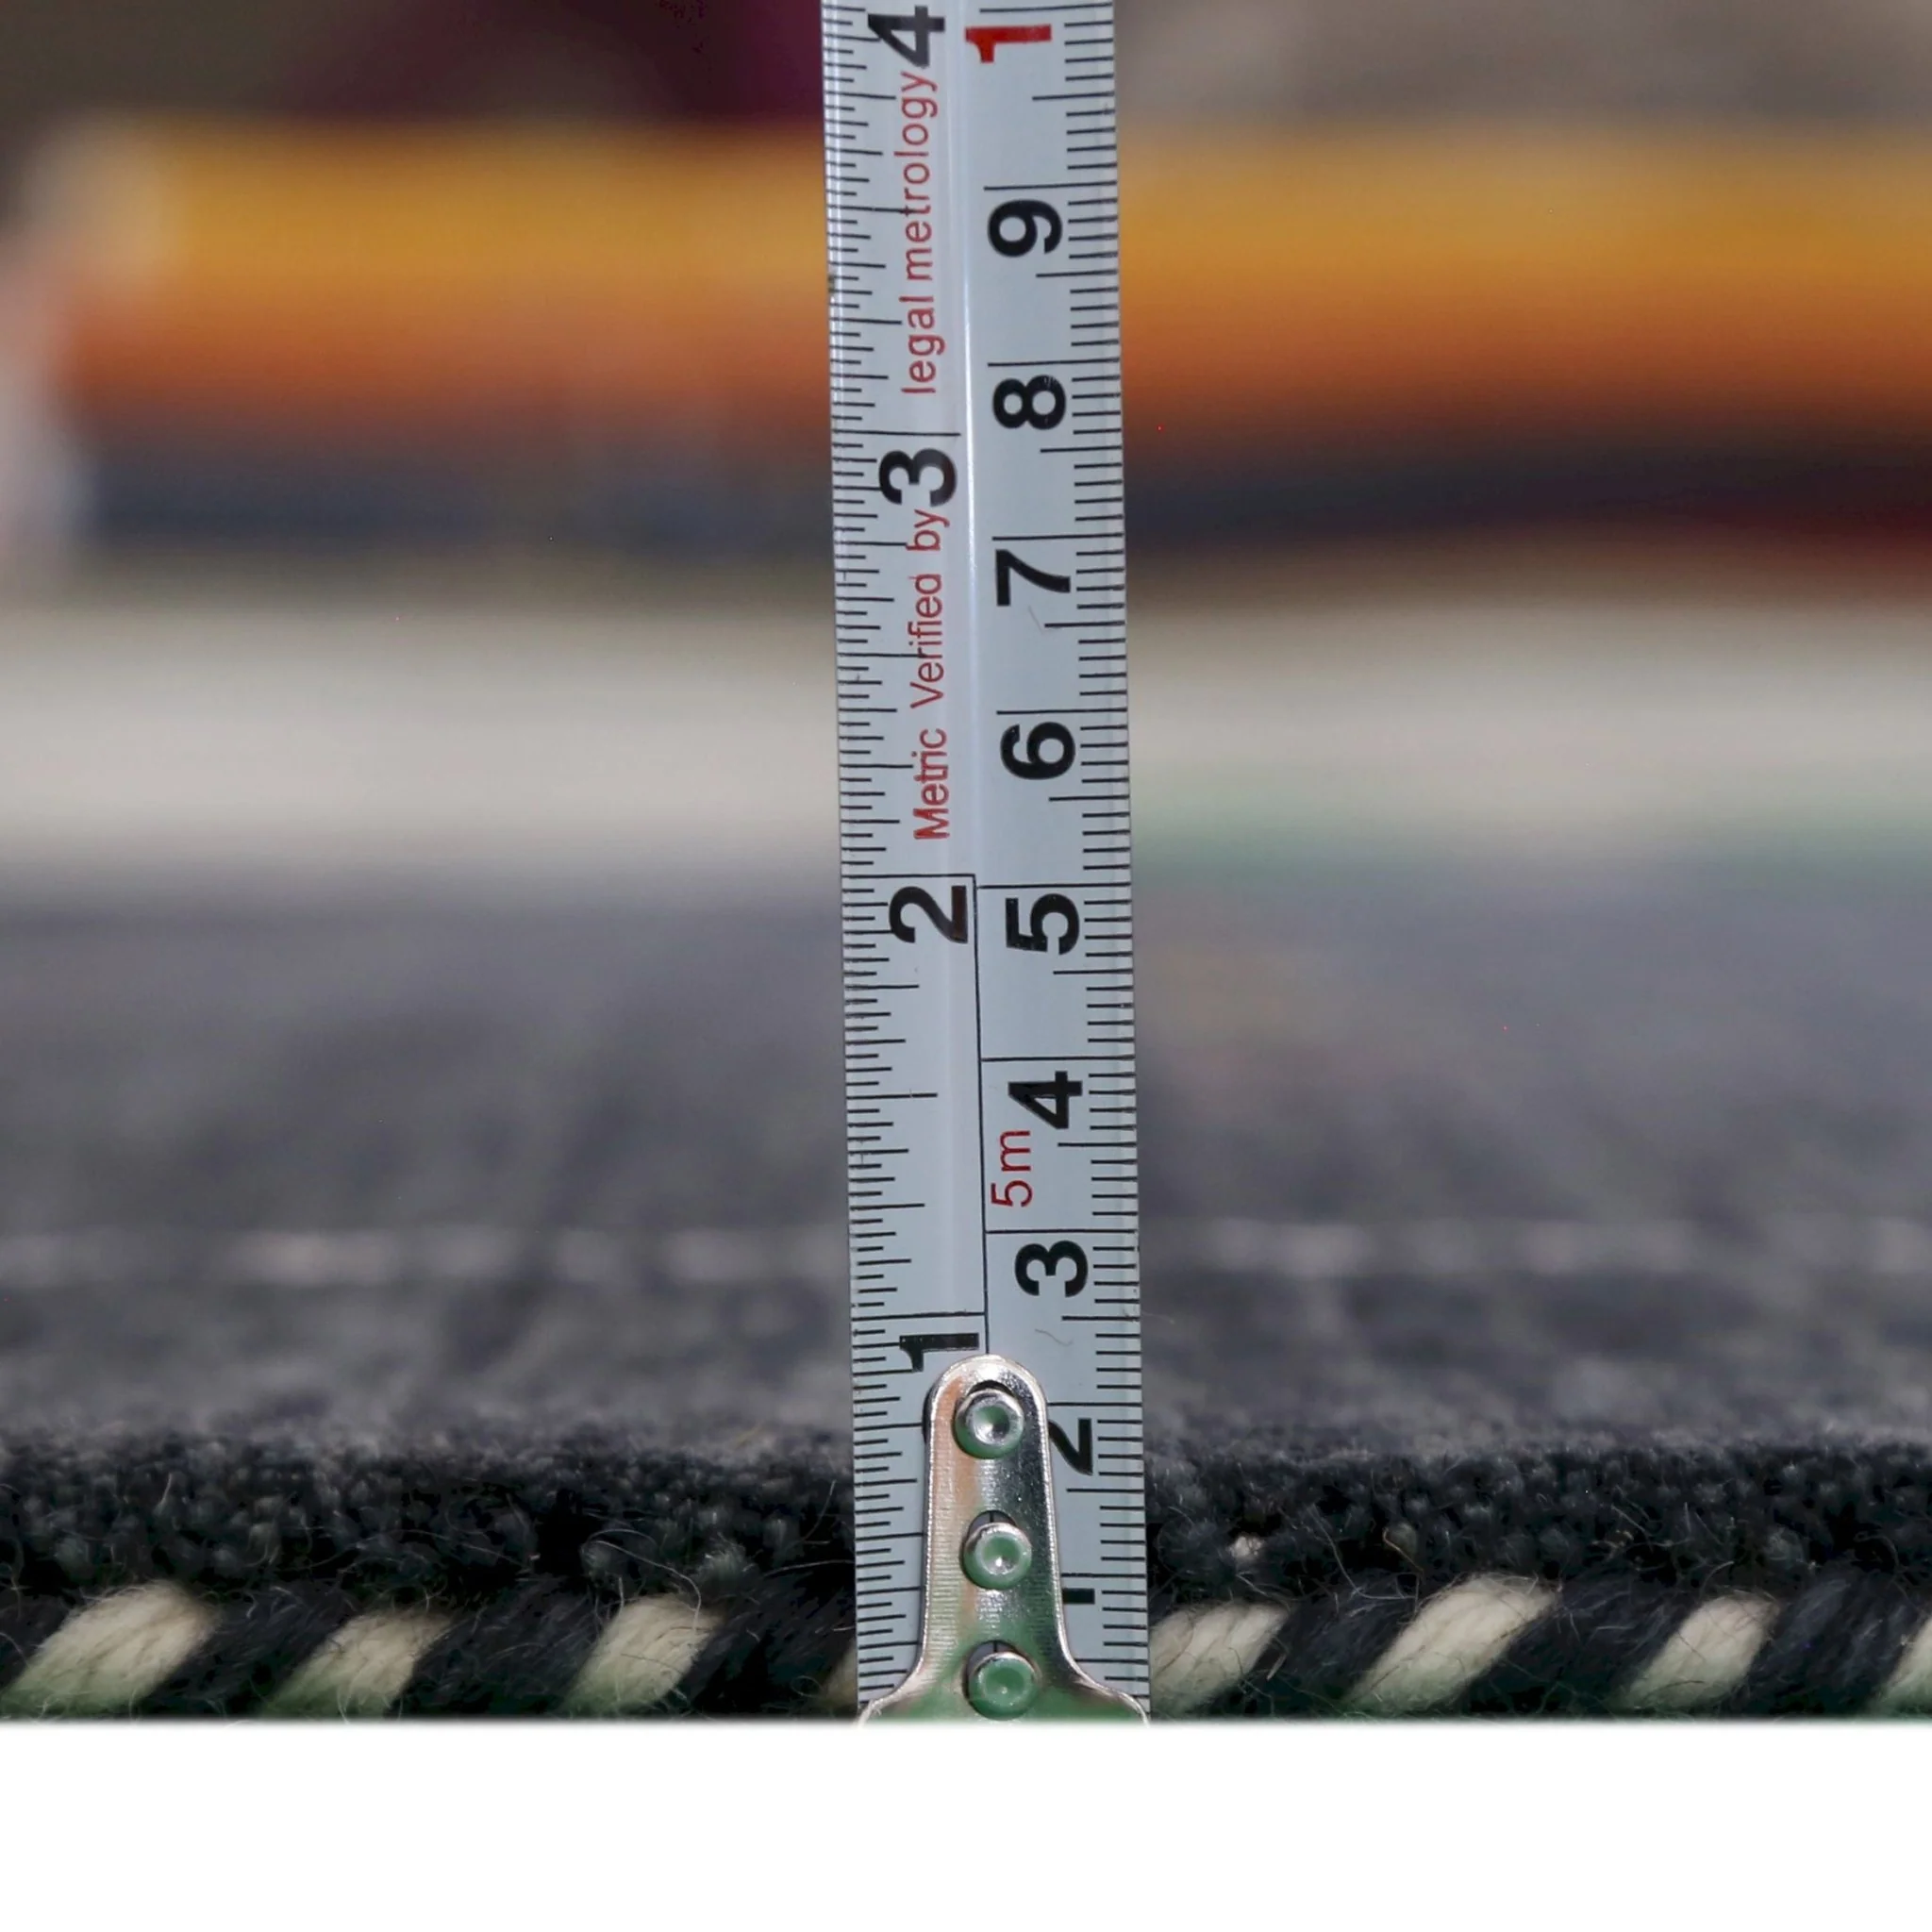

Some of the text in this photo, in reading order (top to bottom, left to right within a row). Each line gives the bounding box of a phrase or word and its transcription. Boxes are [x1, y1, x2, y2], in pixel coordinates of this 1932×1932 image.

[867, 5, 946, 69] 4
[987, 199, 1063, 258] 9
[991, 375, 1067, 431] 8
[877, 448, 958, 508] 3
[893, 72, 950, 841] Metric Verified by legal metrology
[995, 549, 1072, 607] 7
[1000, 721, 1076, 780] 6
[888, 885, 969, 944] 2
[1005, 892, 1080, 956] 5
[1008, 1071, 1083, 1130] 4
[990, 1129, 1035, 1208] 5m
[1014, 1240, 1089, 1298] 3
[899, 1332, 980, 1373] 1
